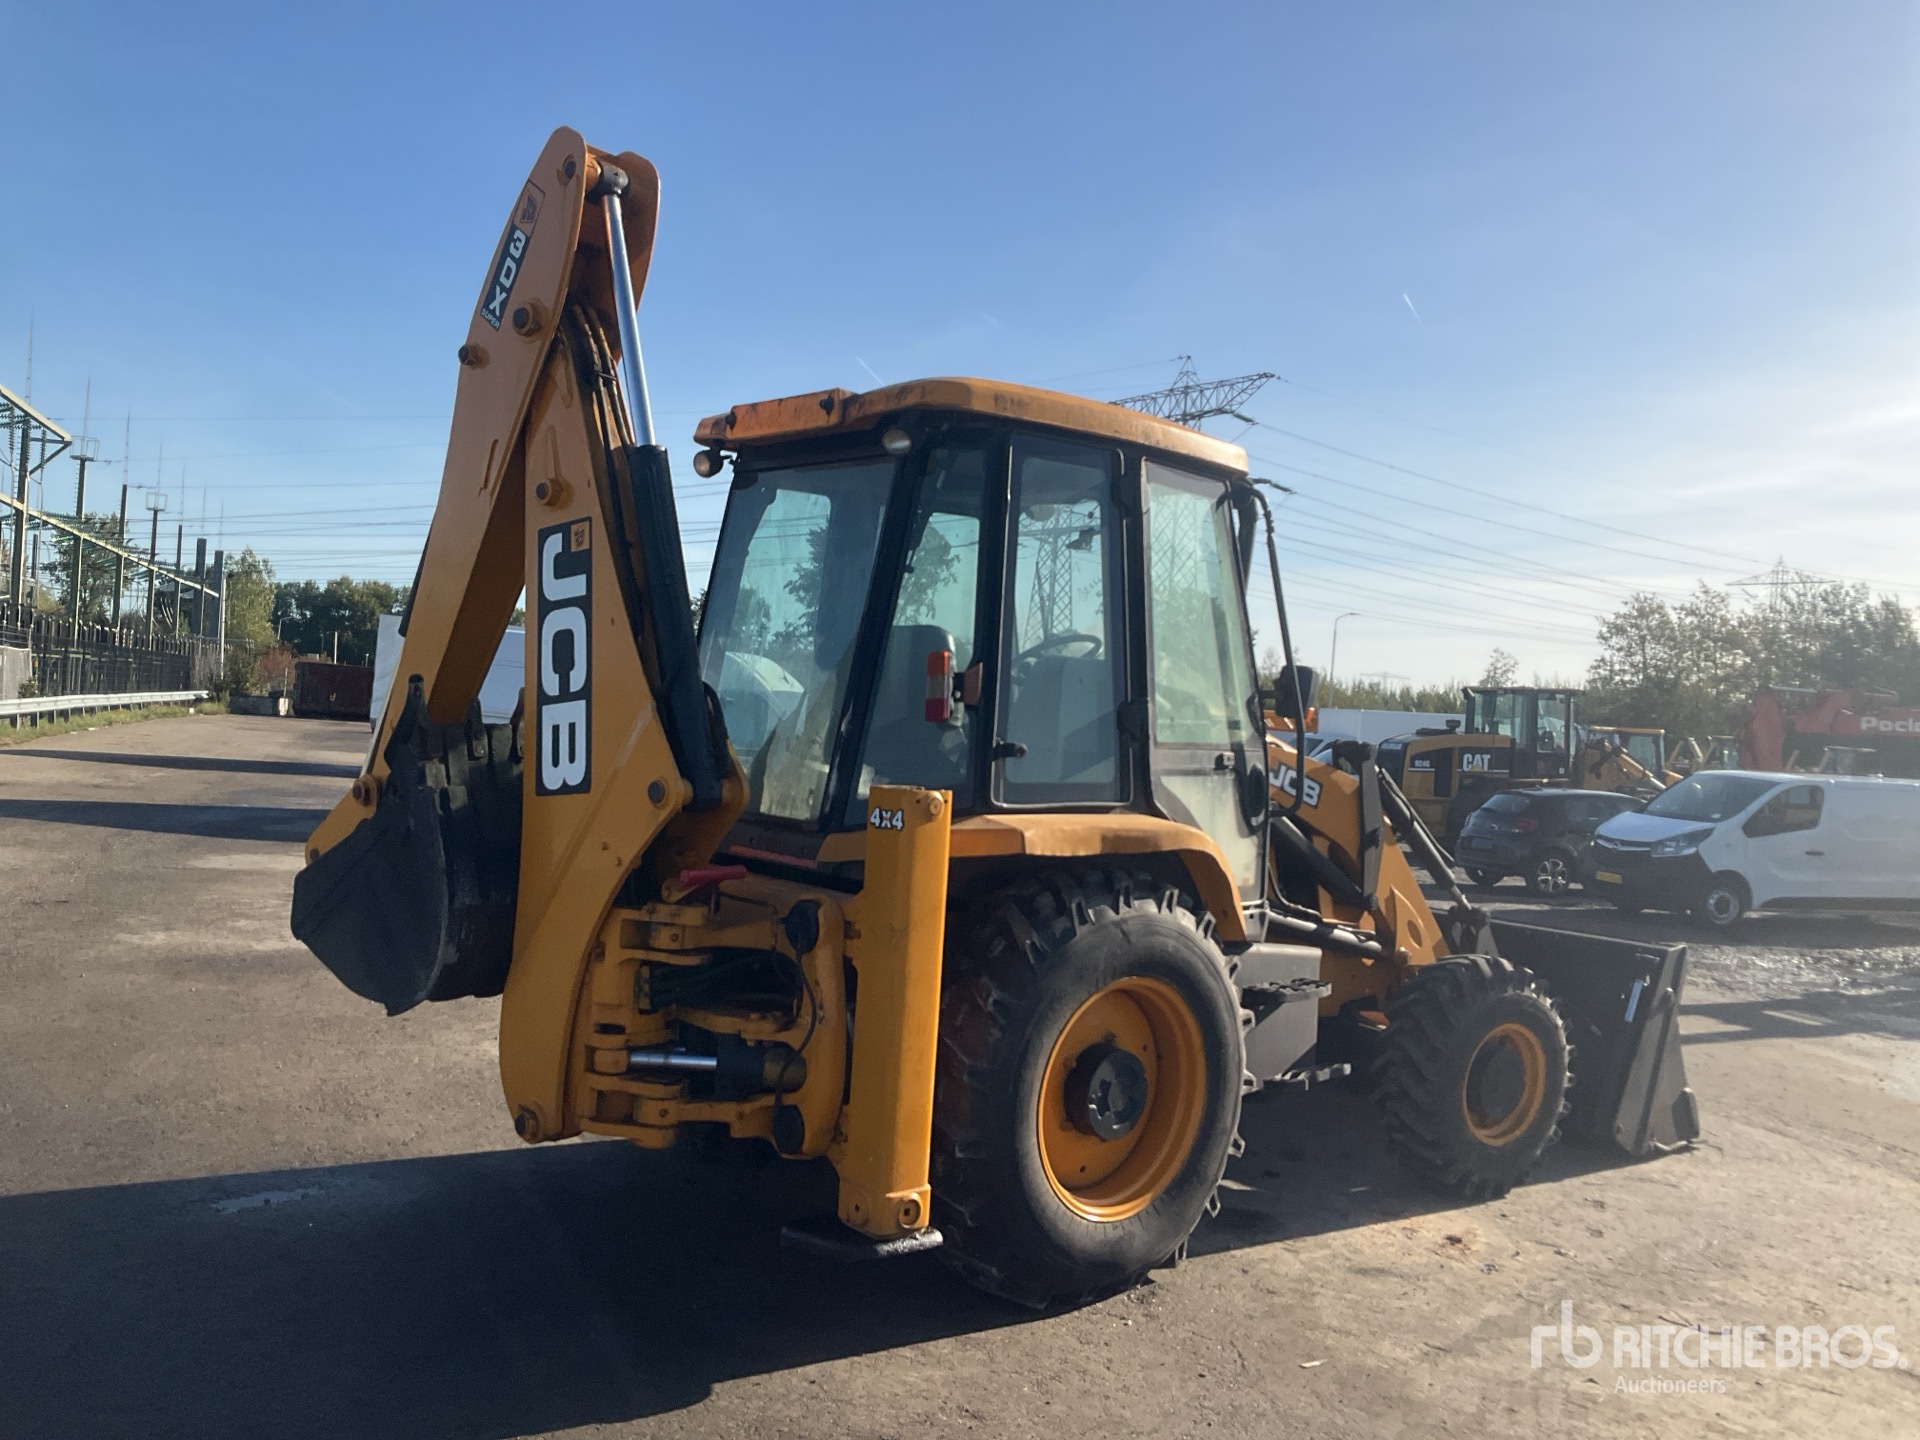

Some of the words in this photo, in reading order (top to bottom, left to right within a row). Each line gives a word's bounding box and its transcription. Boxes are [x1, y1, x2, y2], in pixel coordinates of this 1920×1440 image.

[489, 229, 526, 317] 3DX
[481, 308, 501, 330] SUPER
[541, 531, 588, 791] JCB
[1462, 753, 1491, 772] CAT
[1268, 764, 1320, 806] JCB
